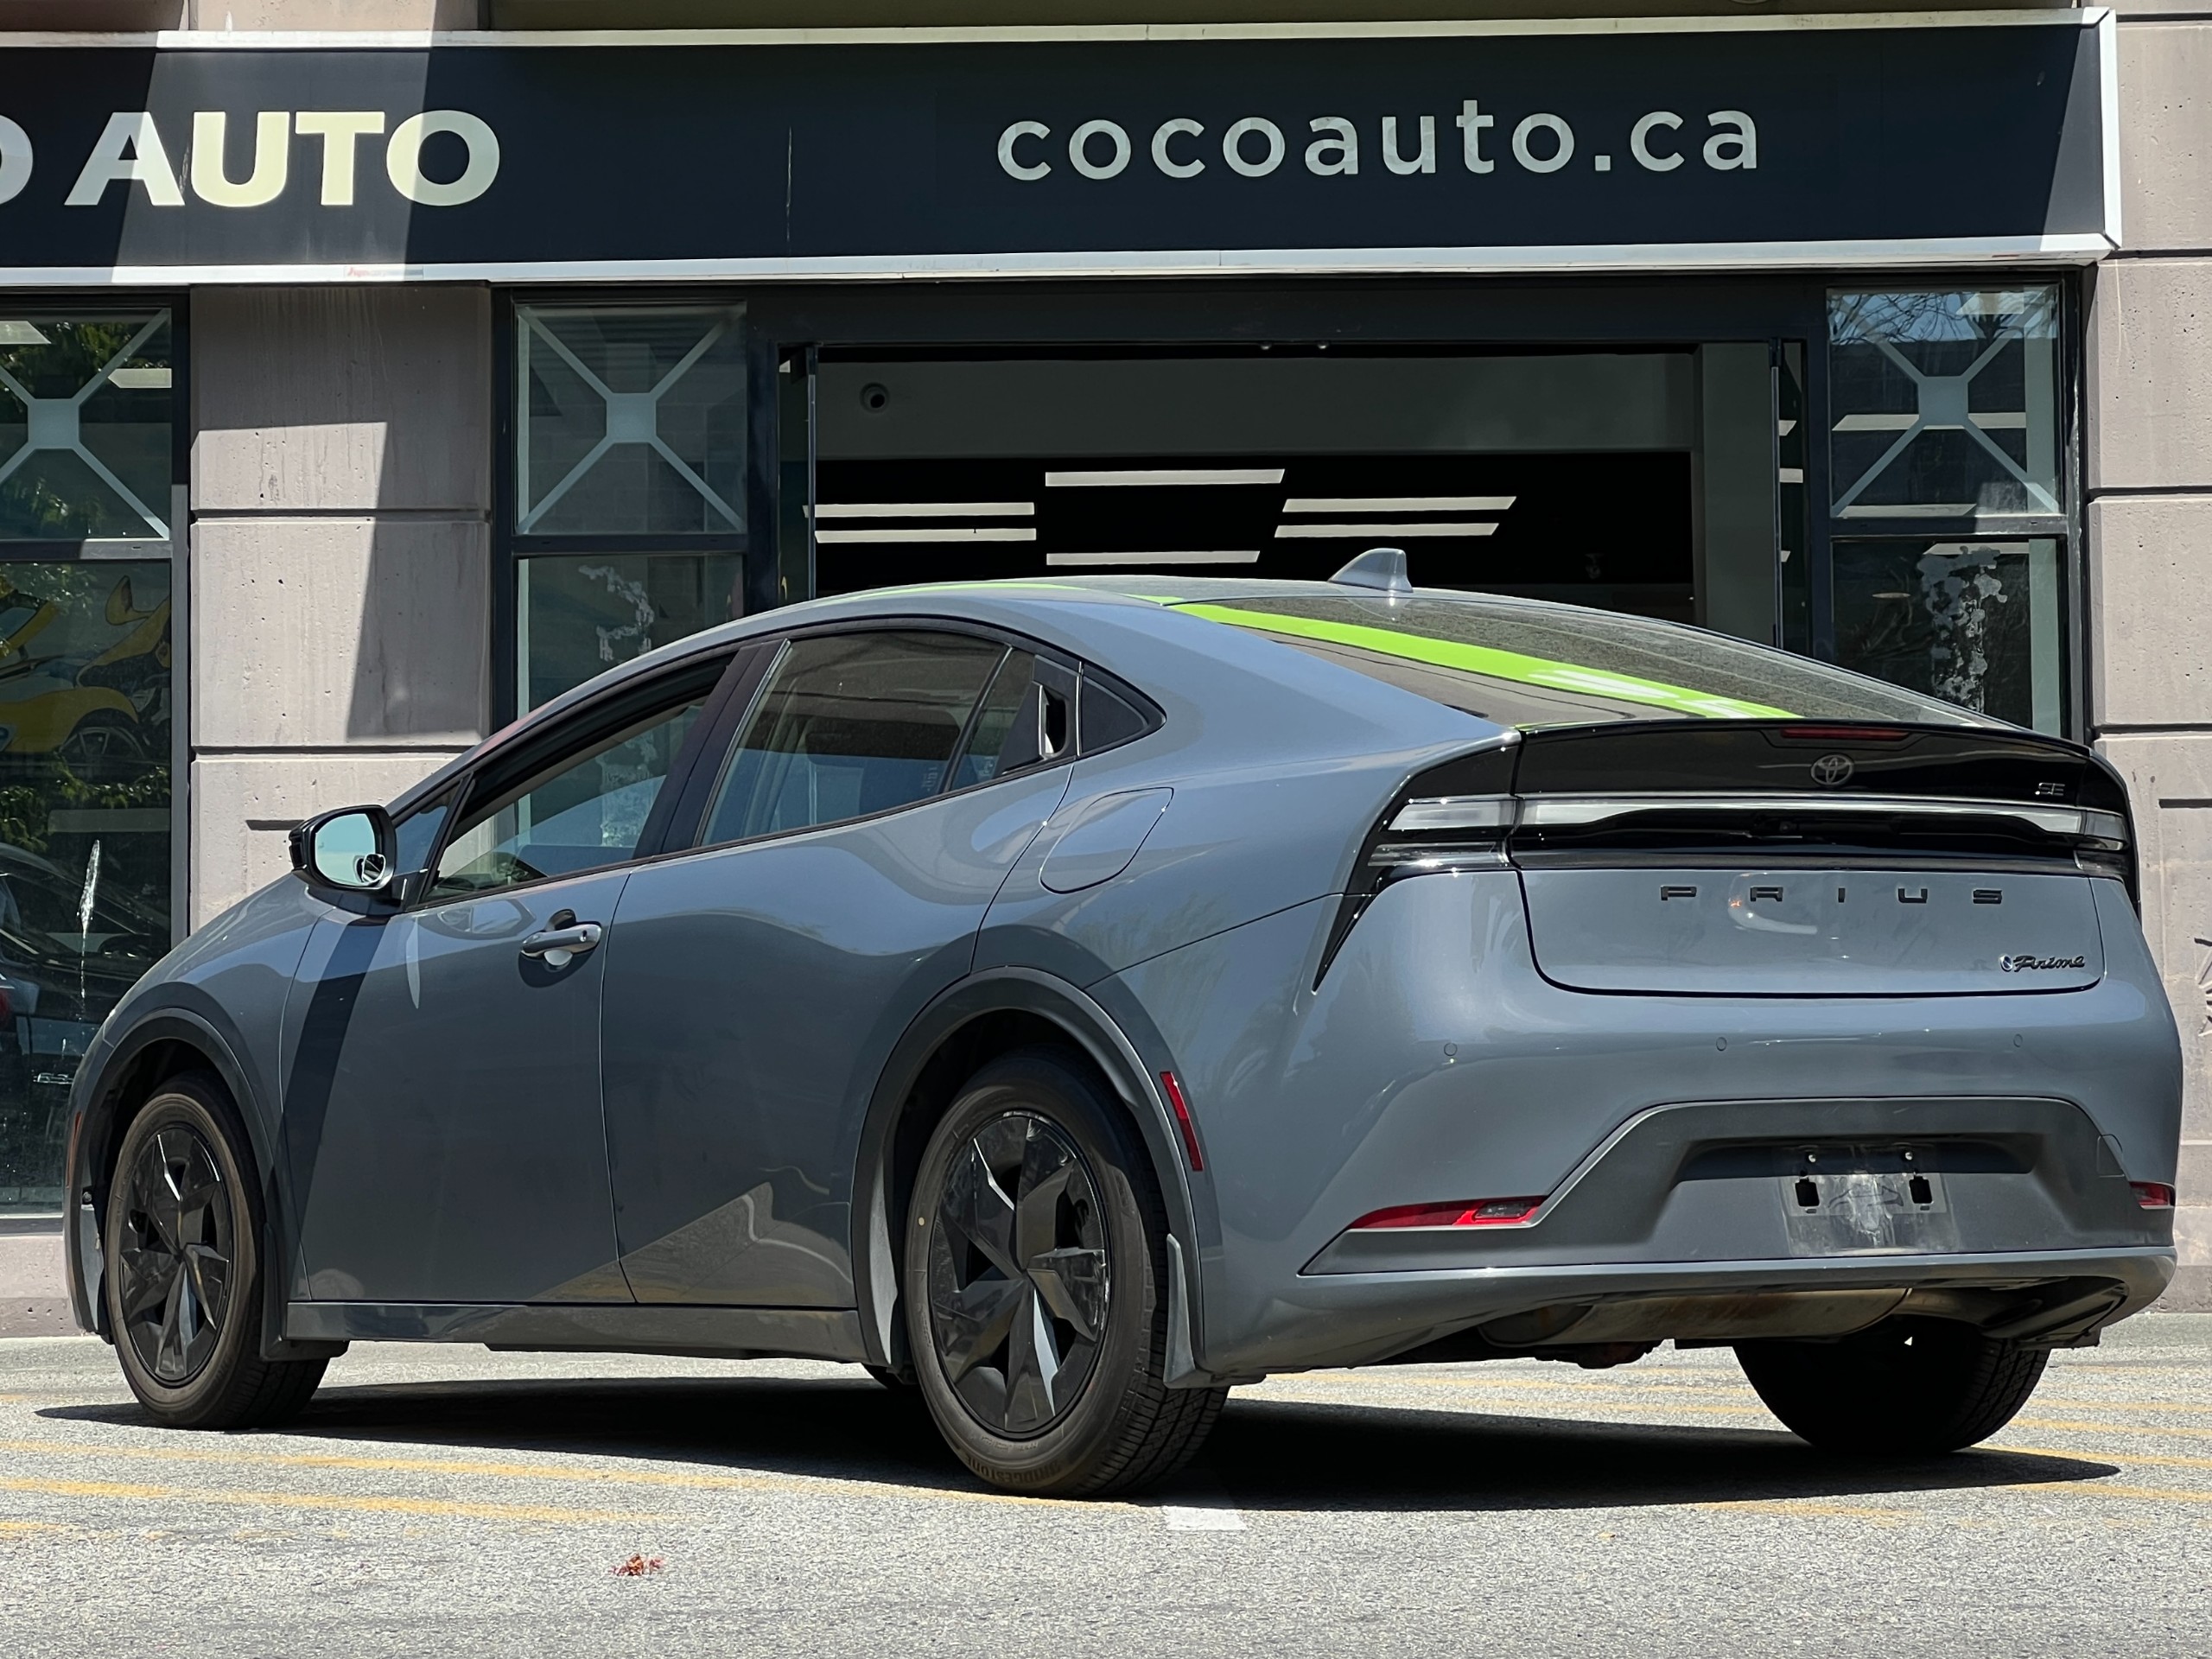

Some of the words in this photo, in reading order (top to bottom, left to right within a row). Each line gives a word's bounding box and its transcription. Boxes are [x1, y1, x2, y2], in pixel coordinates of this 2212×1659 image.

[997, 99, 1758, 181] cocoauto.ca
[64, 109, 501, 207] AUTO
[2035, 782, 2066, 796] SE
[1660, 885, 2004, 905] PRIUS
[2012, 955, 2086, 973] Prime
